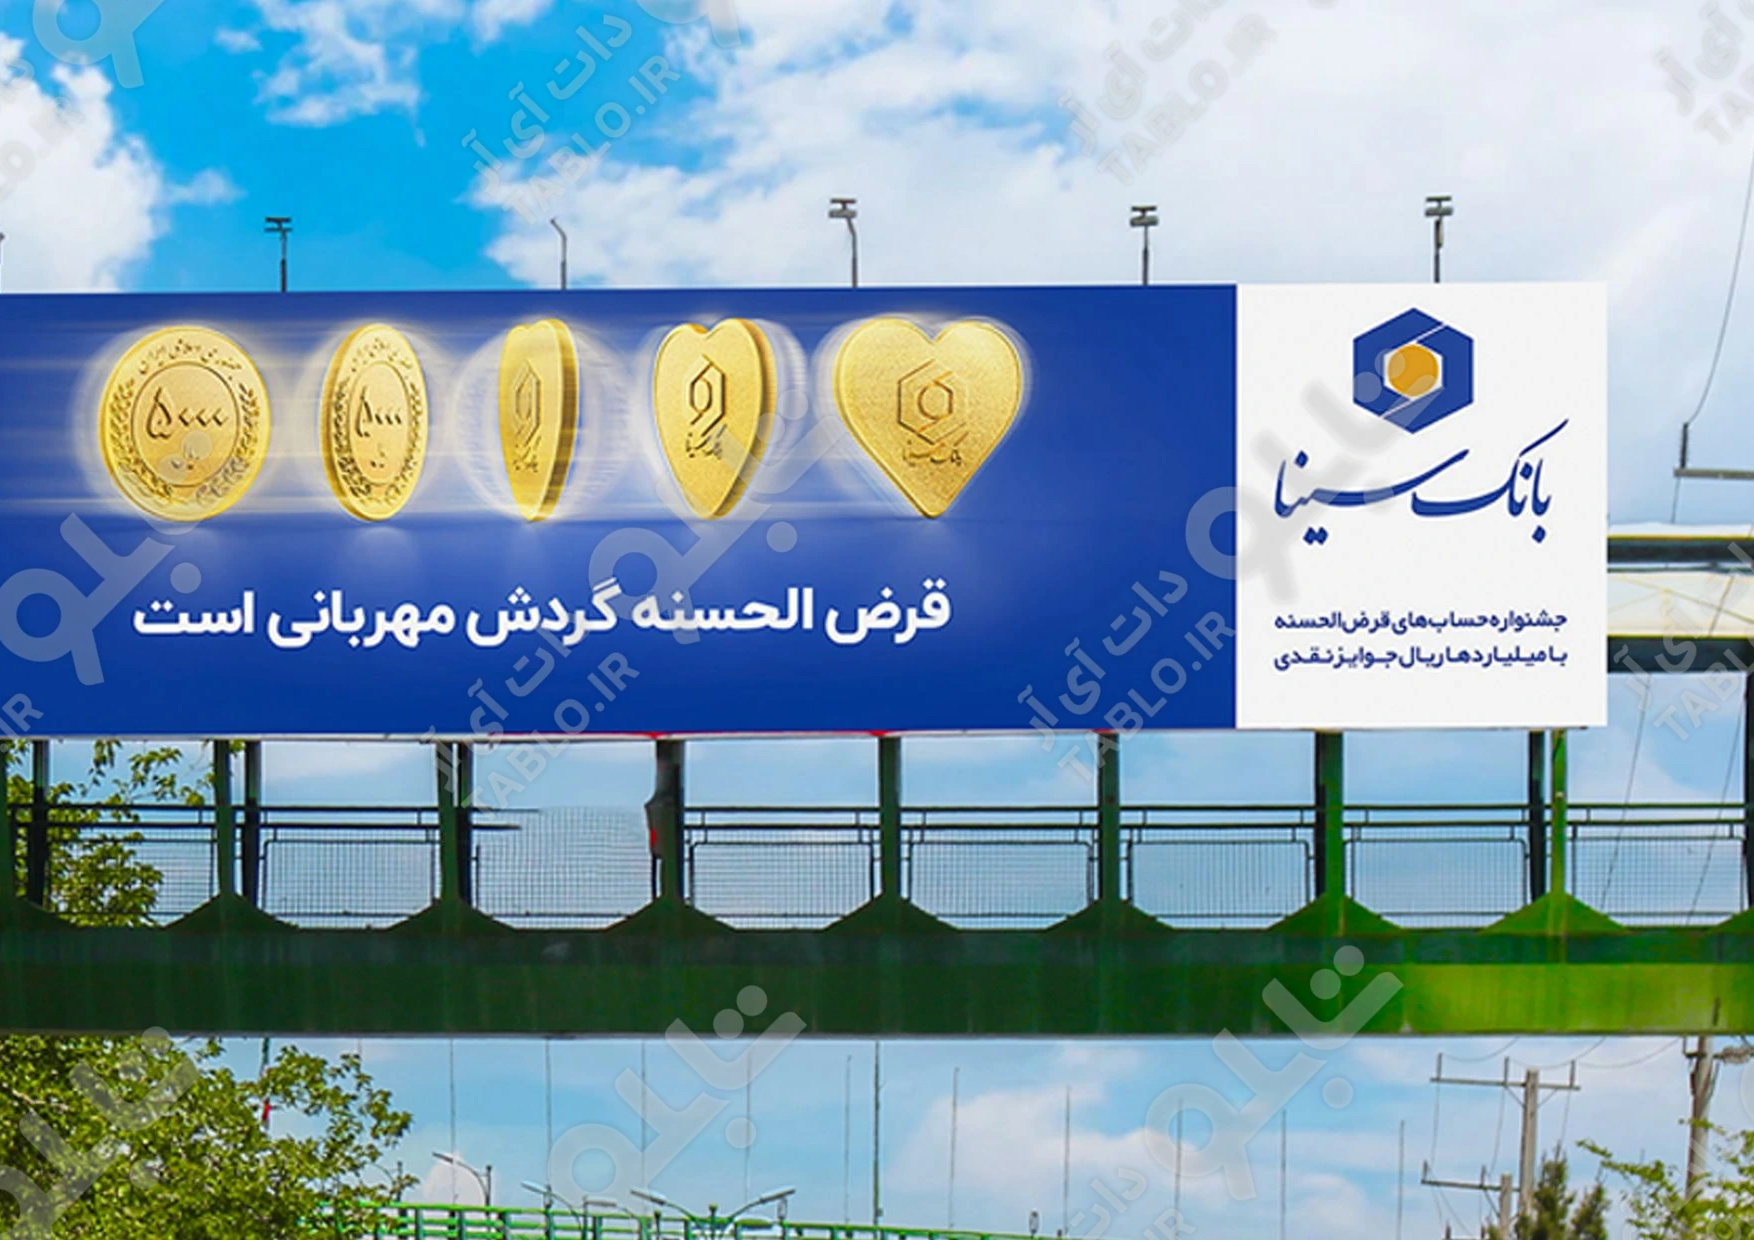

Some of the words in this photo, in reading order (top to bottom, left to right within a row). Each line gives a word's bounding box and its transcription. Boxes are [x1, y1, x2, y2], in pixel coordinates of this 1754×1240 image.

[1274, 449, 1470, 545] سینا
[1412, 419, 1569, 543] بانک
[134, 591, 255, 634] است
[267, 589, 456, 649] مهربانی
[466, 577, 622, 647] گردش
[632, 586, 815, 631] الحسنه
[824, 577, 953, 645] قرض
[1489, 610, 1568, 632] جشنواره
[1274, 646, 1334, 671] نقدی
[1333, 646, 1398, 669] جوایز
[1398, 646, 1446, 669] ریال
